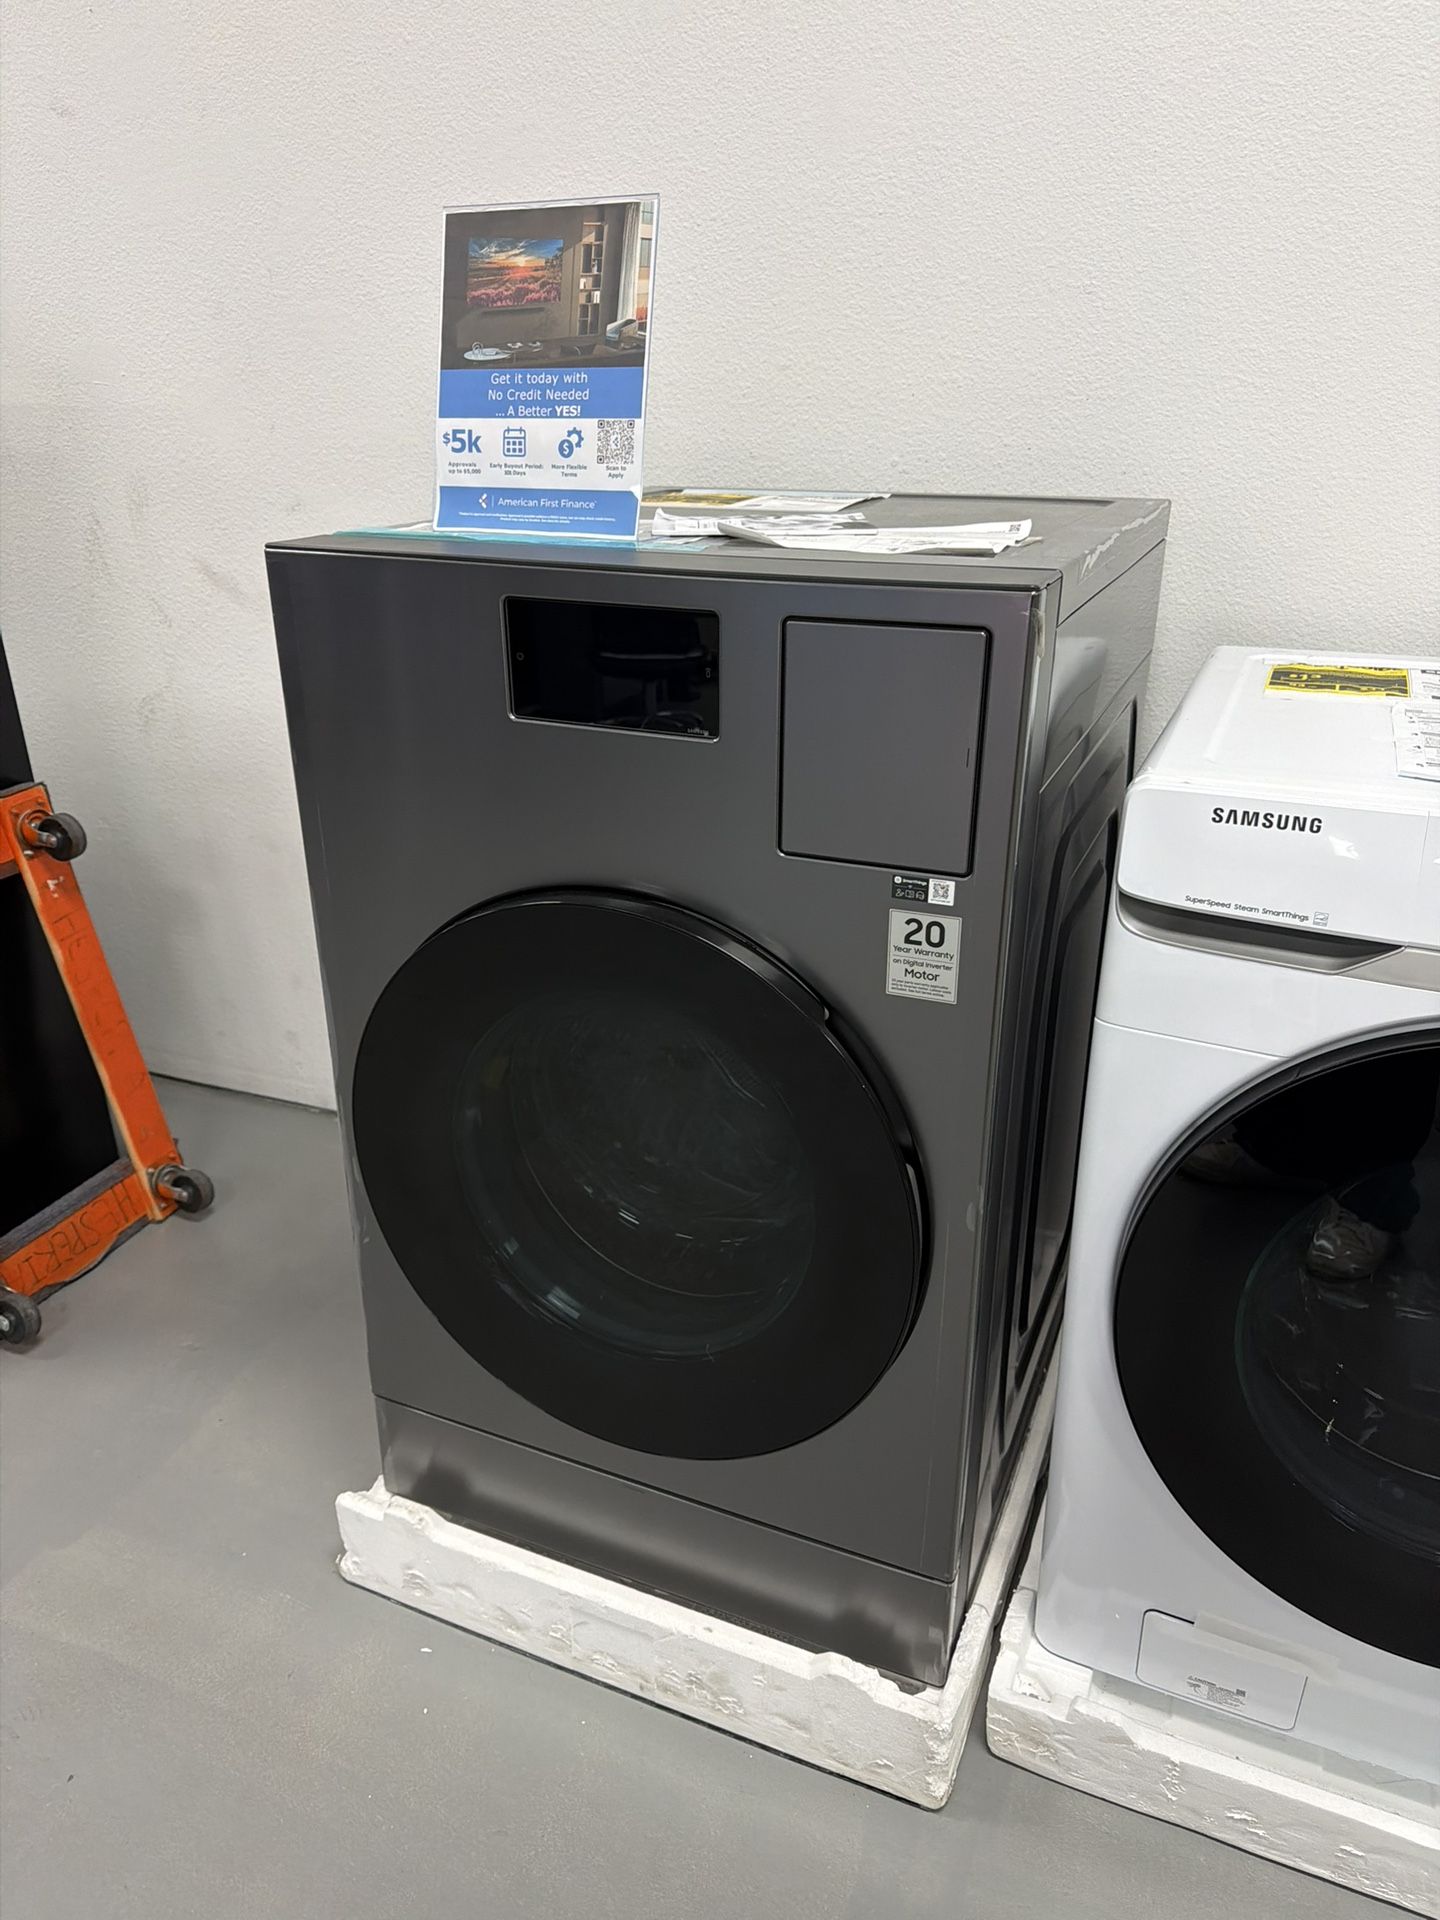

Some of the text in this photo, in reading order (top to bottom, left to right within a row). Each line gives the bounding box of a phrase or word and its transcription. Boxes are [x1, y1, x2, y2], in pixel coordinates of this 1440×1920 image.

[491, 372, 588, 386] Get it today with
[488, 388, 590, 400] No Credit Needed
[507, 406, 515, 416] A
[518, 406, 552, 416] Better
[555, 405, 581, 416] YES!
[442, 429, 482, 453] $5k
[497, 497, 596, 510] American First Finance
[1211, 807, 1322, 834] SAMSUNG
[1184, 895, 1310, 923] SuperSpeed Steam SmartThings
[904, 918, 946, 948] 20
[893, 945, 955, 961] Year Warranty
[903, 959, 924, 968] Digital
[926, 962, 953, 971] Inverter
[904, 968, 940, 982] Motor
